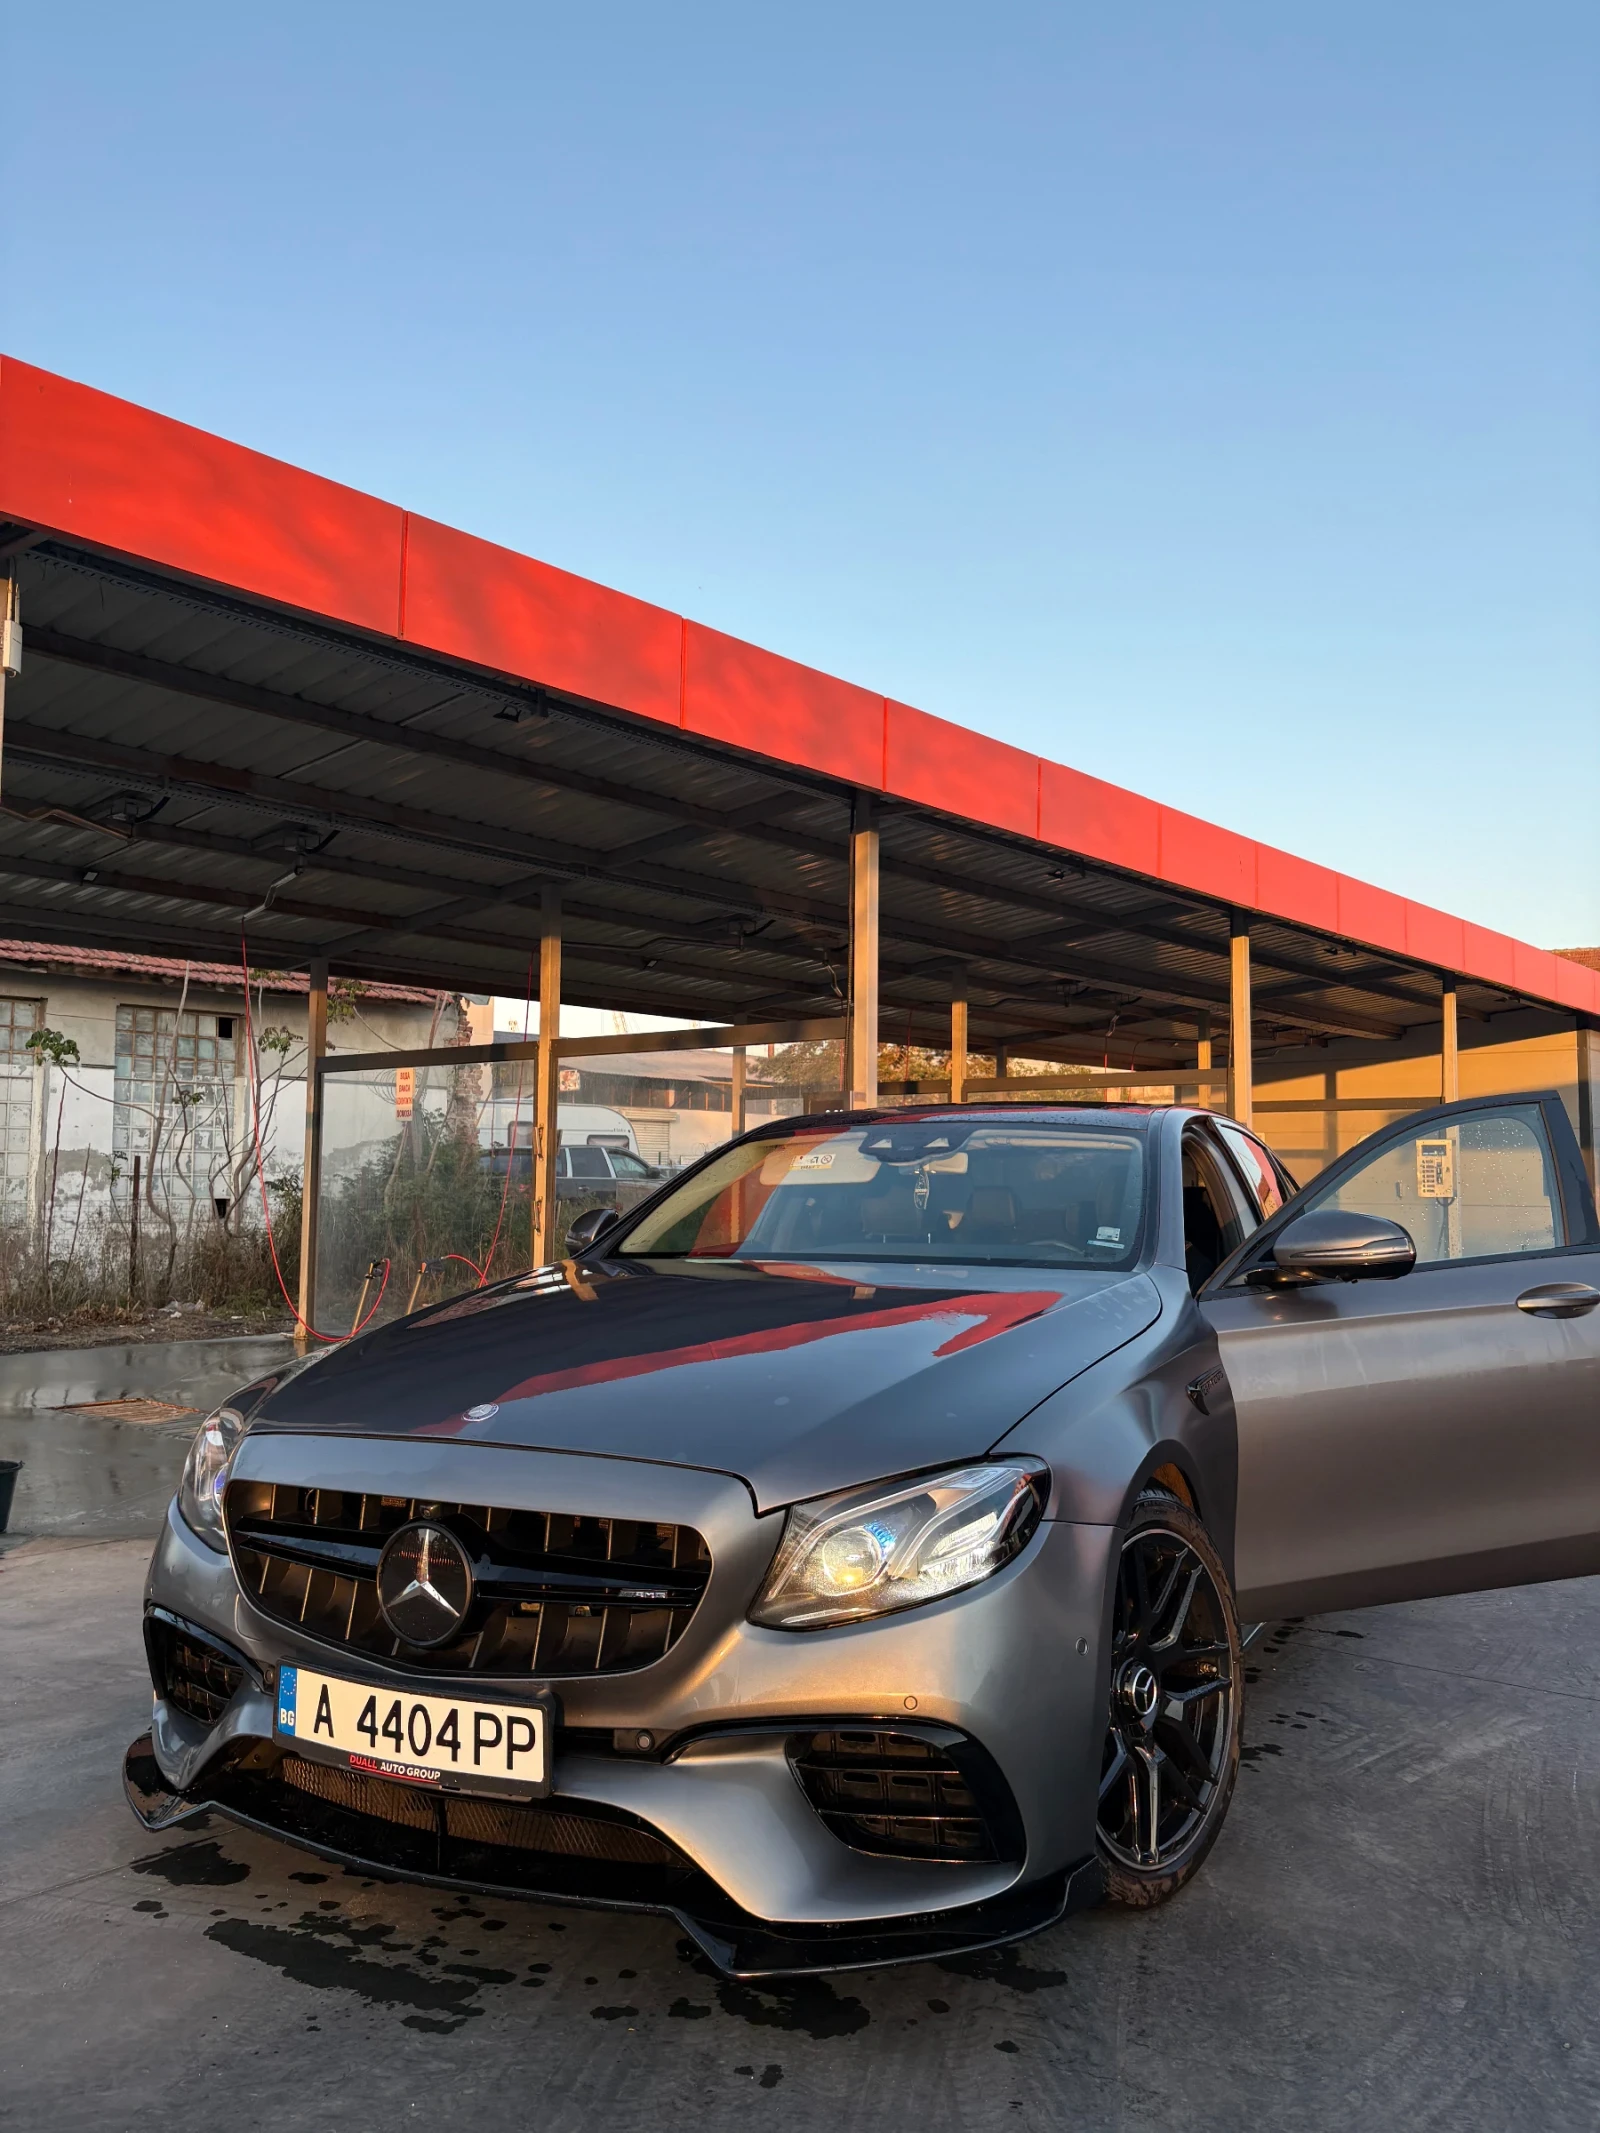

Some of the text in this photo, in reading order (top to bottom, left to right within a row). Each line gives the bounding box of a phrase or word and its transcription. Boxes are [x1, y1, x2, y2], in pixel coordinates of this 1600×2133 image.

[280, 1708, 295, 1726] BG
[313, 1683, 334, 1738] A
[349, 1754, 441, 1780] DUALL AUTO GROUP
